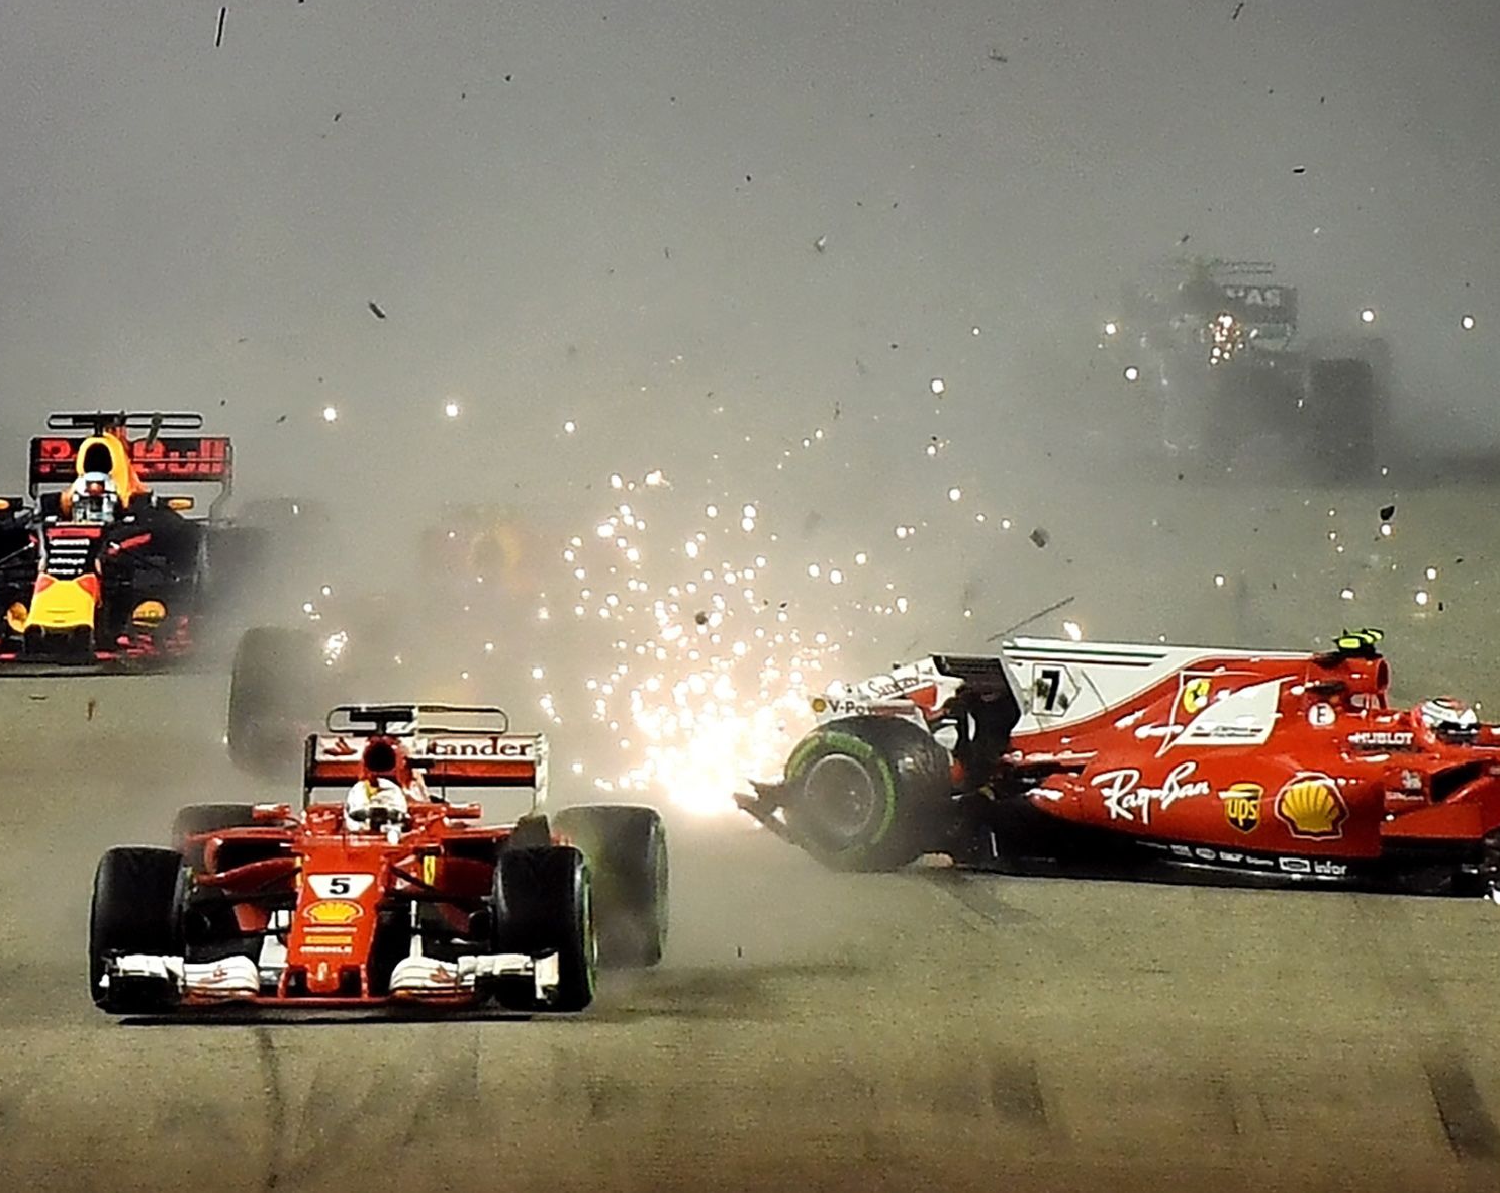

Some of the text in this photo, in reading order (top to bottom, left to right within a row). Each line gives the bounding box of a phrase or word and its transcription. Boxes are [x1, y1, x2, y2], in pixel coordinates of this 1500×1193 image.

[1041, 669, 1060, 711] 7
[1315, 704, 1329, 724] E
[428, 736, 534, 757] tander
[1353, 731, 1414, 745] HUBLOT
[1091, 761, 1211, 825] Ray-Ban
[1226, 796, 1260, 827] ups
[329, 877, 351, 895] 5
